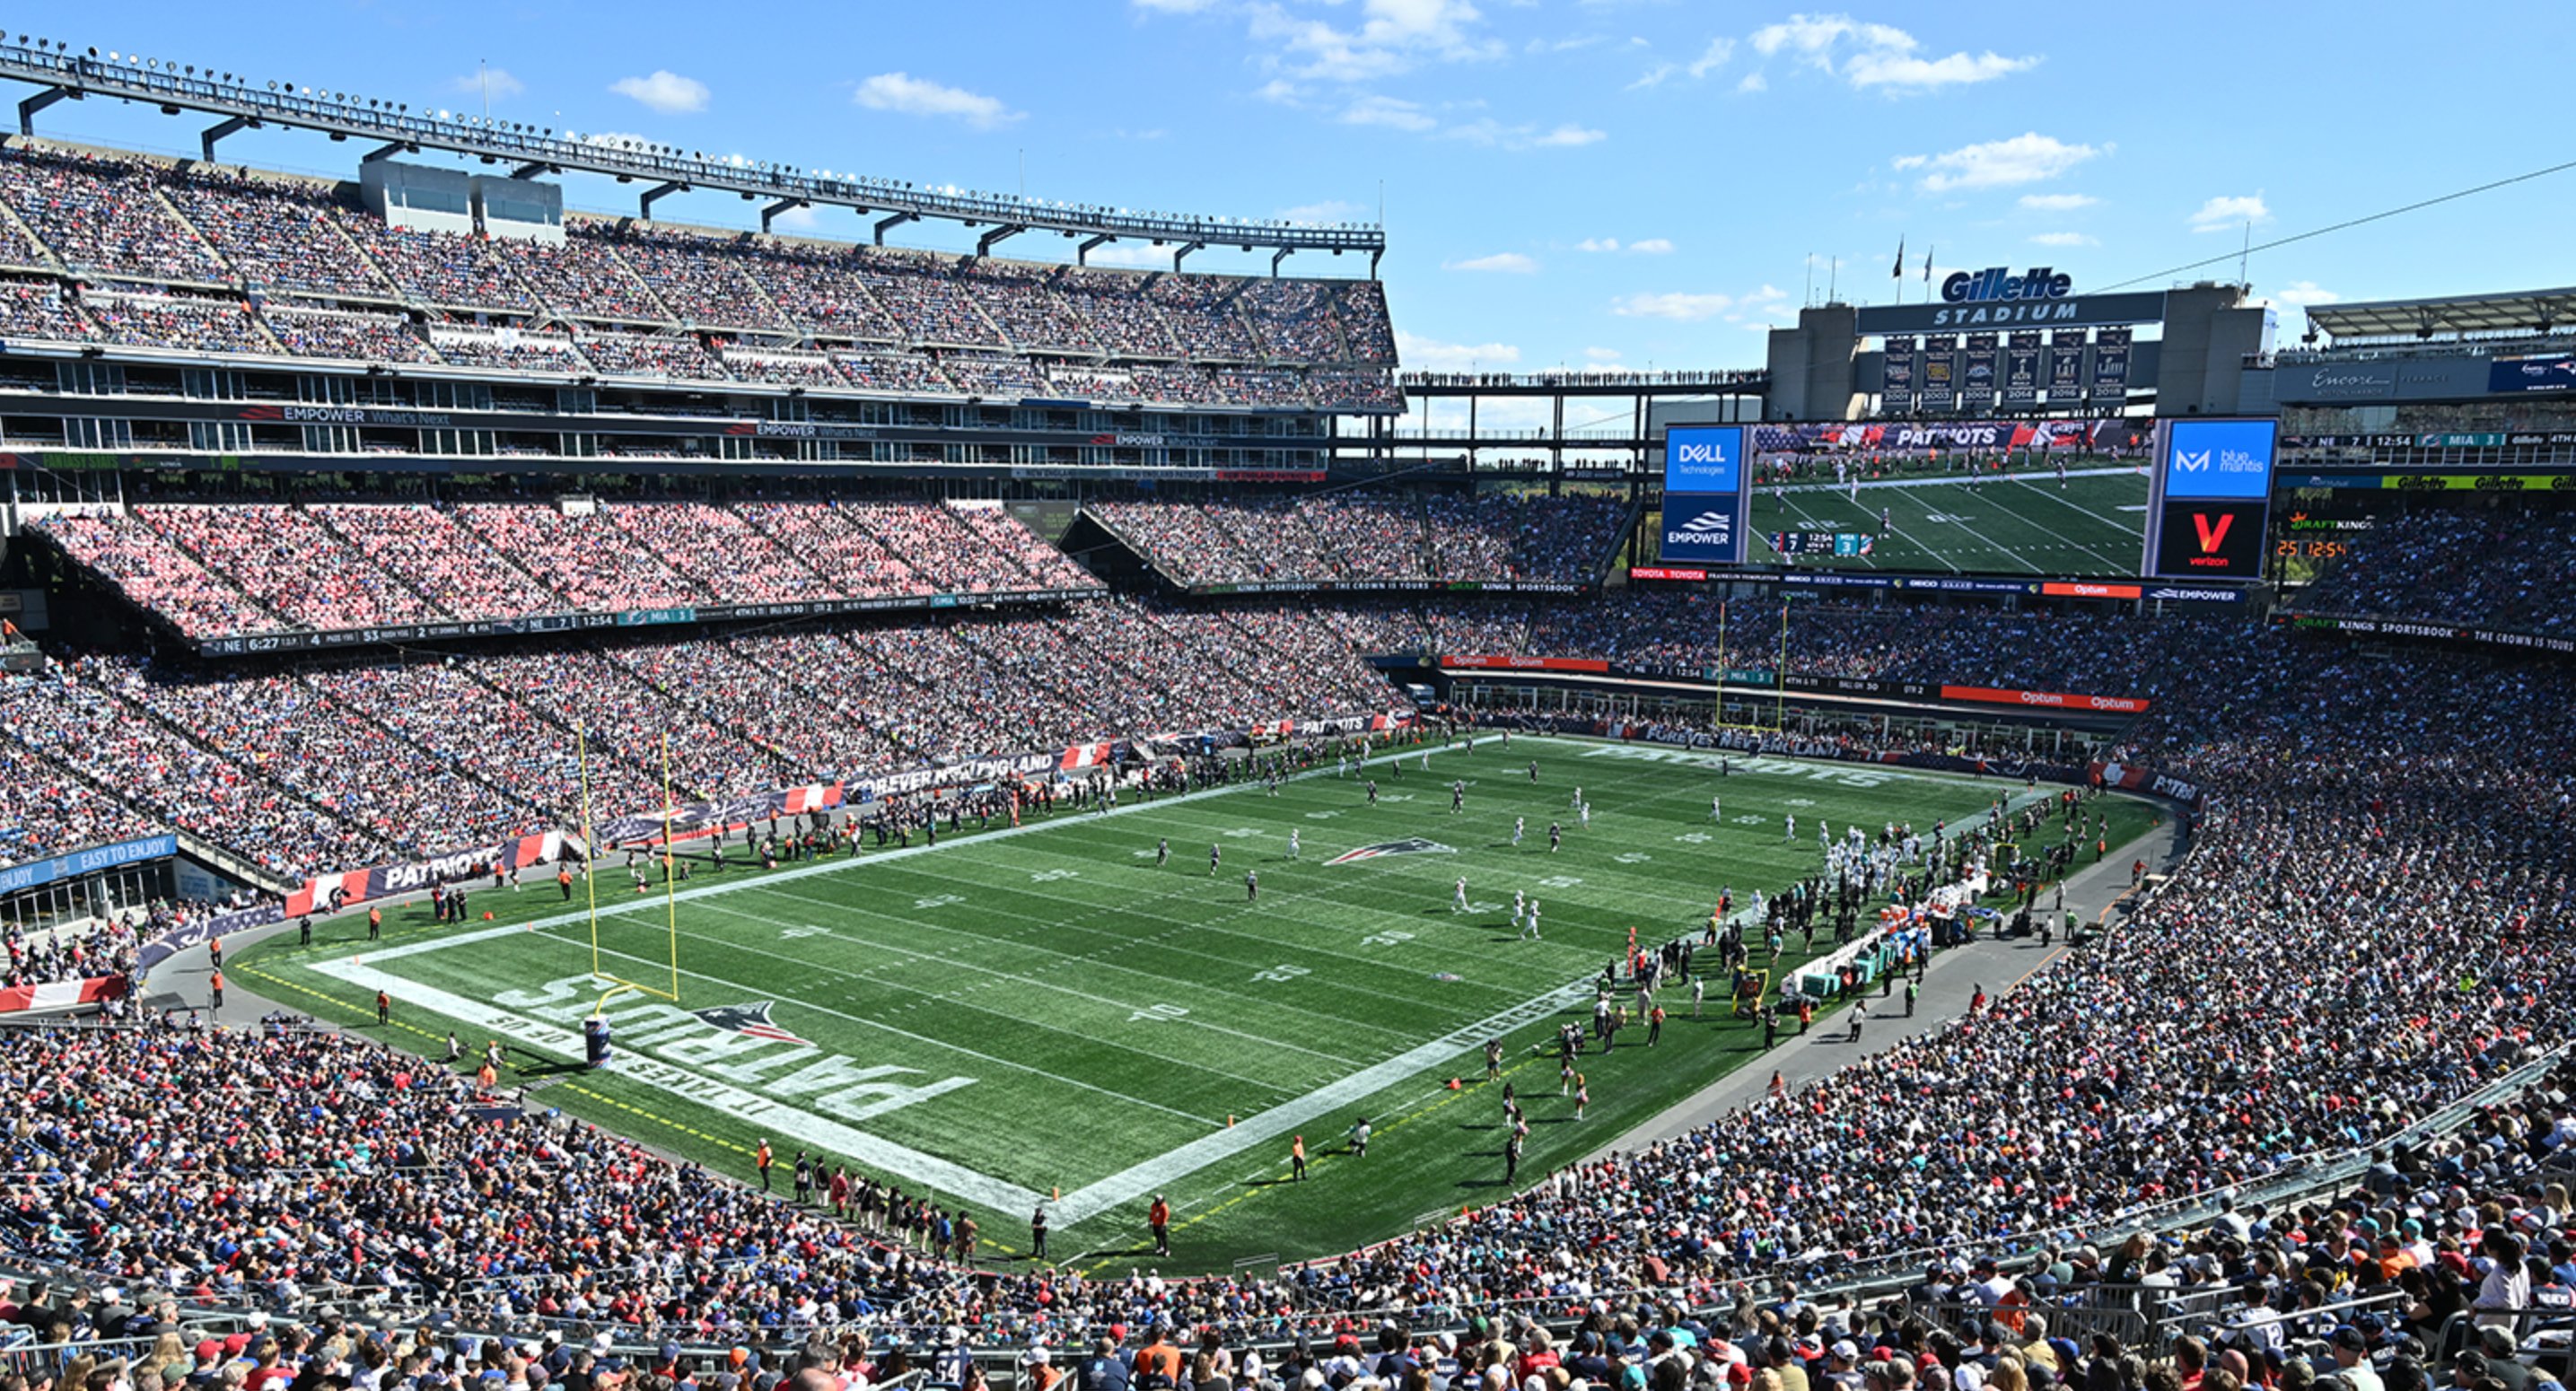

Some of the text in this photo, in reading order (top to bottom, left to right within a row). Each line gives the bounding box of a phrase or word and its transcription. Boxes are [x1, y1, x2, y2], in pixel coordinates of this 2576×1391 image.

[1941, 267, 2072, 303] Gillette
[1932, 302, 2078, 326] STADIUM
[2312, 367, 2390, 389] Encore
[1885, 392, 1908, 401] 2001
[1924, 390, 1950, 400] 2003
[1965, 390, 1991, 399] 2004
[2007, 390, 2032, 398] 2014
[2052, 388, 2077, 398] 2016
[284, 407, 451, 425] EMPOWER What's Next
[757, 424, 878, 438] EMPOWER What's Next
[1115, 435, 1165, 446] EMPOWER
[2318, 434, 2494, 446] NE 7 12:54 MIA 3
[1678, 444, 1726, 462] DELL
[2220, 450, 2250, 462] blue
[1679, 465, 1725, 476] Technologies
[2219, 459, 2264, 473] mantis
[2397, 477, 2447, 490] Gillette
[2475, 477, 2525, 490] Gillette
[1668, 531, 1729, 546] EMPOWER
[1790, 539, 1852, 551] 7 3
[2276, 540, 2347, 556] 25 12:54
[2188, 556, 2229, 567] verizon
[1631, 568, 1705, 580] TOYOTA TOYOTA
[2074, 584, 2108, 595] Optum
[2178, 591, 2237, 601] EMPOWER
[792, 603, 804, 614] 30
[826, 602, 834, 612] 2
[651, 610, 670, 621] MIA
[679, 609, 686, 621] 3
[467, 623, 476, 634] 4
[530, 616, 613, 629] NE 7 12:54
[363, 630, 380, 642] 53
[417, 626, 426, 638] 2
[2380, 623, 2454, 639] SPORTSBOOK
[2475, 630, 2493, 642] THE
[2495, 632, 2532, 646] CROWN
[2534, 635, 2545, 648] IS
[2546, 638, 2575, 652] YOURS
[224, 640, 242, 652] NE
[248, 637, 279, 651] 6:27
[310, 634, 321, 646] 4
[1452, 656, 1544, 667] Optum Optum
[1676, 668, 1701, 678] 12:54
[1730, 672, 1748, 682] MIA
[1757, 672, 1765, 683] 3
[1917, 686, 1924, 695] 2
[2021, 691, 2134, 710] Optum Optum
[2, 868, 34, 889] ENJOY
[81, 853, 109, 870] EASY
[110, 848, 127, 865] TO
[127, 838, 168, 858] ENJOY
